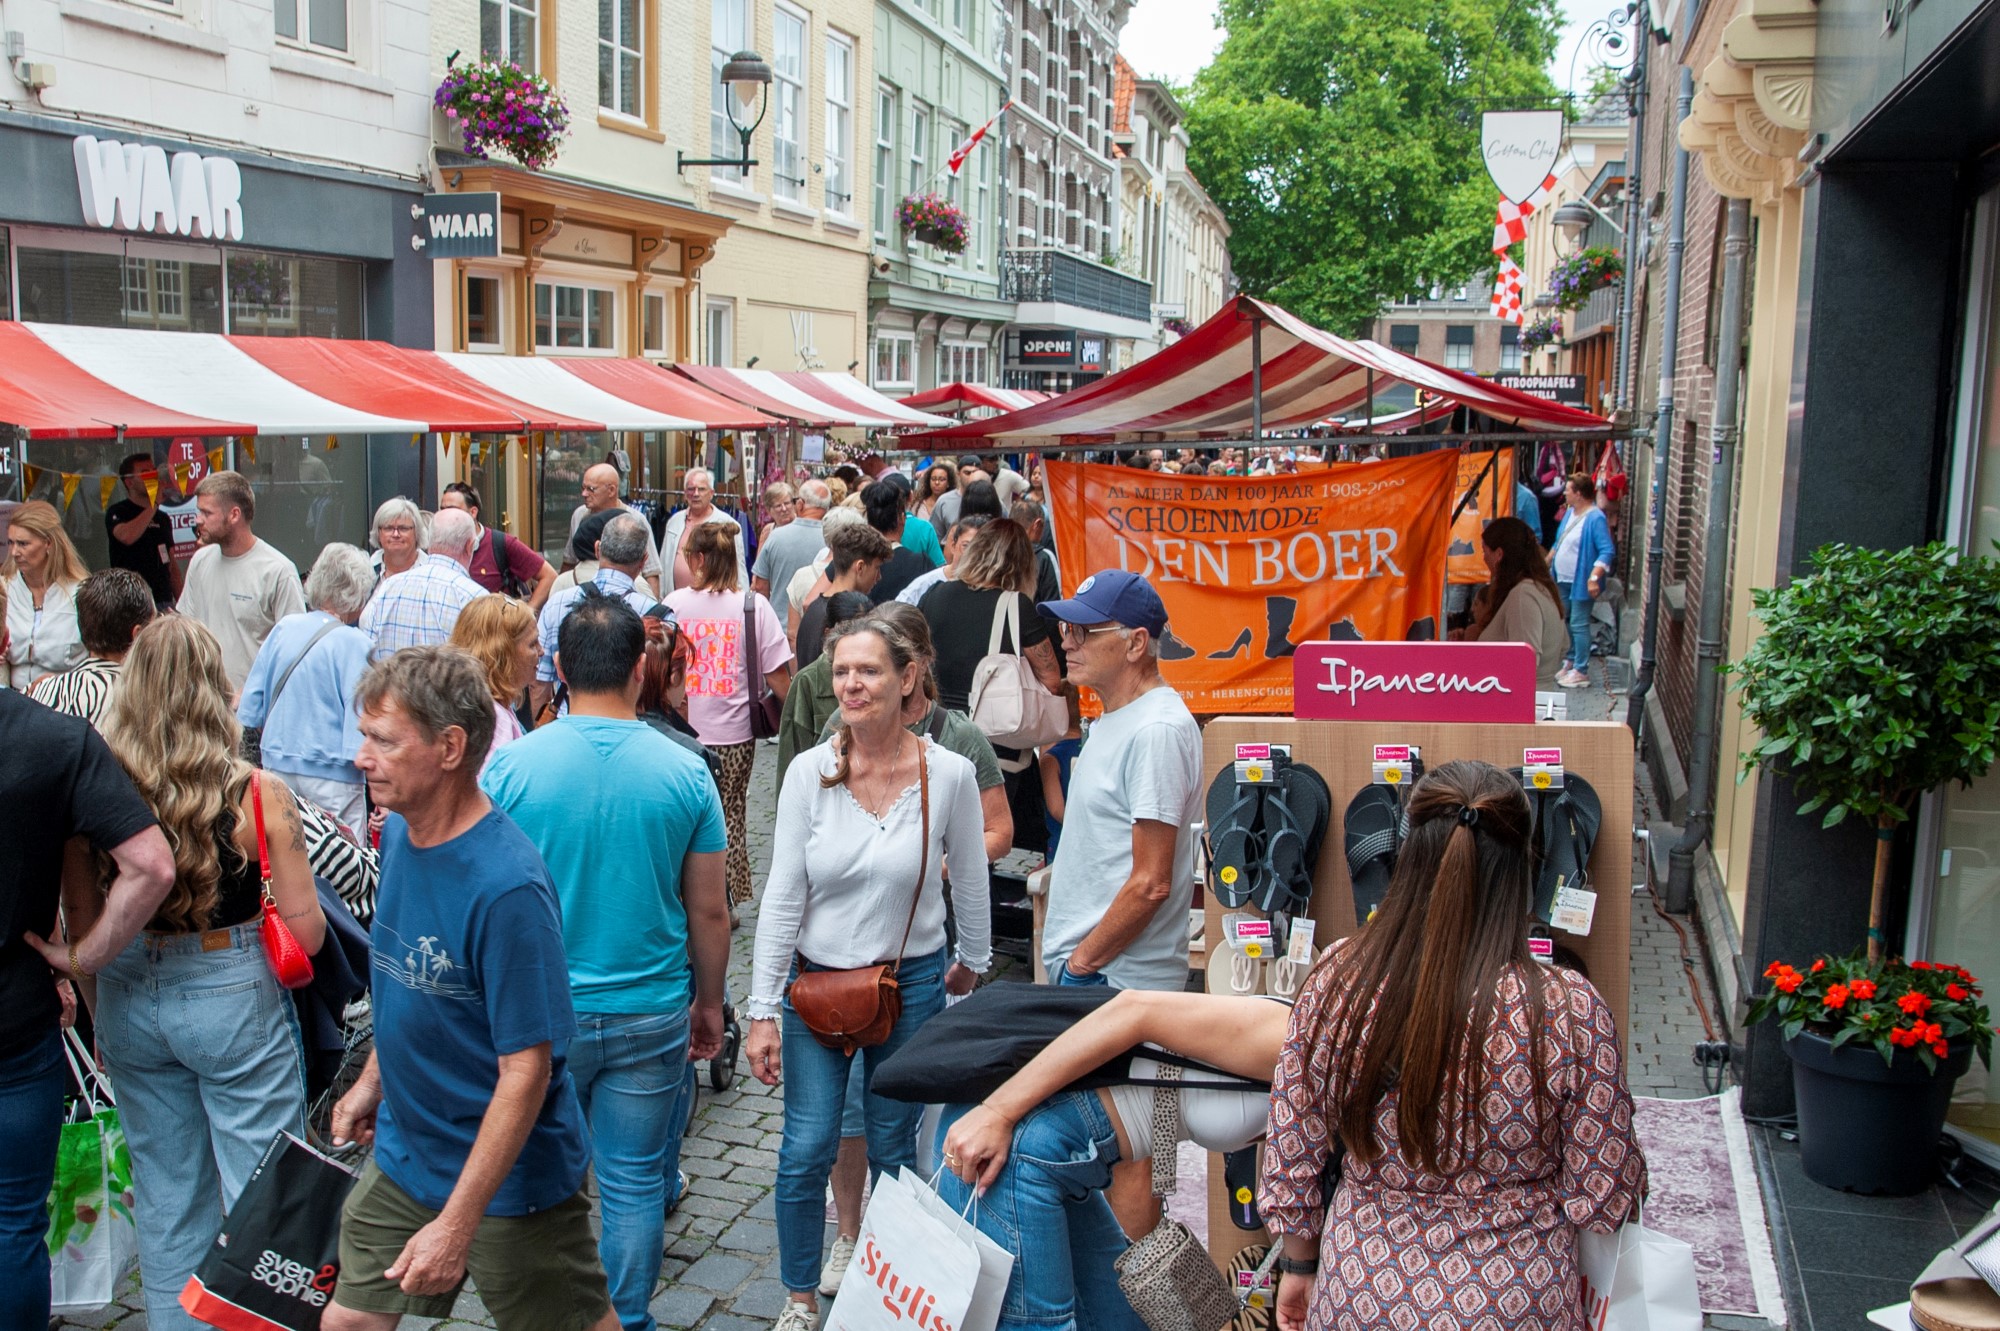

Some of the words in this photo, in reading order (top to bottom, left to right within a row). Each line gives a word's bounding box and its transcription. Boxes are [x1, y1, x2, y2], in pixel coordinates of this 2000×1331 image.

[1486, 139, 1527, 159] Cotton
[1529, 139, 1555, 160] Club
[73, 135, 243, 241] WAAR
[429, 213, 493, 238] WAAR
[1501, 377, 1576, 389] STROOPWAFELS
[181, 443, 193, 460] TE
[1107, 486, 1129, 498] AL
[1135, 487, 1184, 500] MEER
[1191, 487, 1228, 501] DAN
[1237, 487, 1266, 500] 100
[1271, 485, 1314, 502] JAAR
[1108, 506, 1323, 532] SCHOENMODE
[1114, 535, 1230, 586] DEN
[1247, 528, 1405, 586] BOER
[1212, 686, 1294, 699] HERENSCHOE
[1317, 657, 1511, 707] Ipanema
[1535, 776, 1549, 784] 50%
[252, 1265, 327, 1307] sophie
